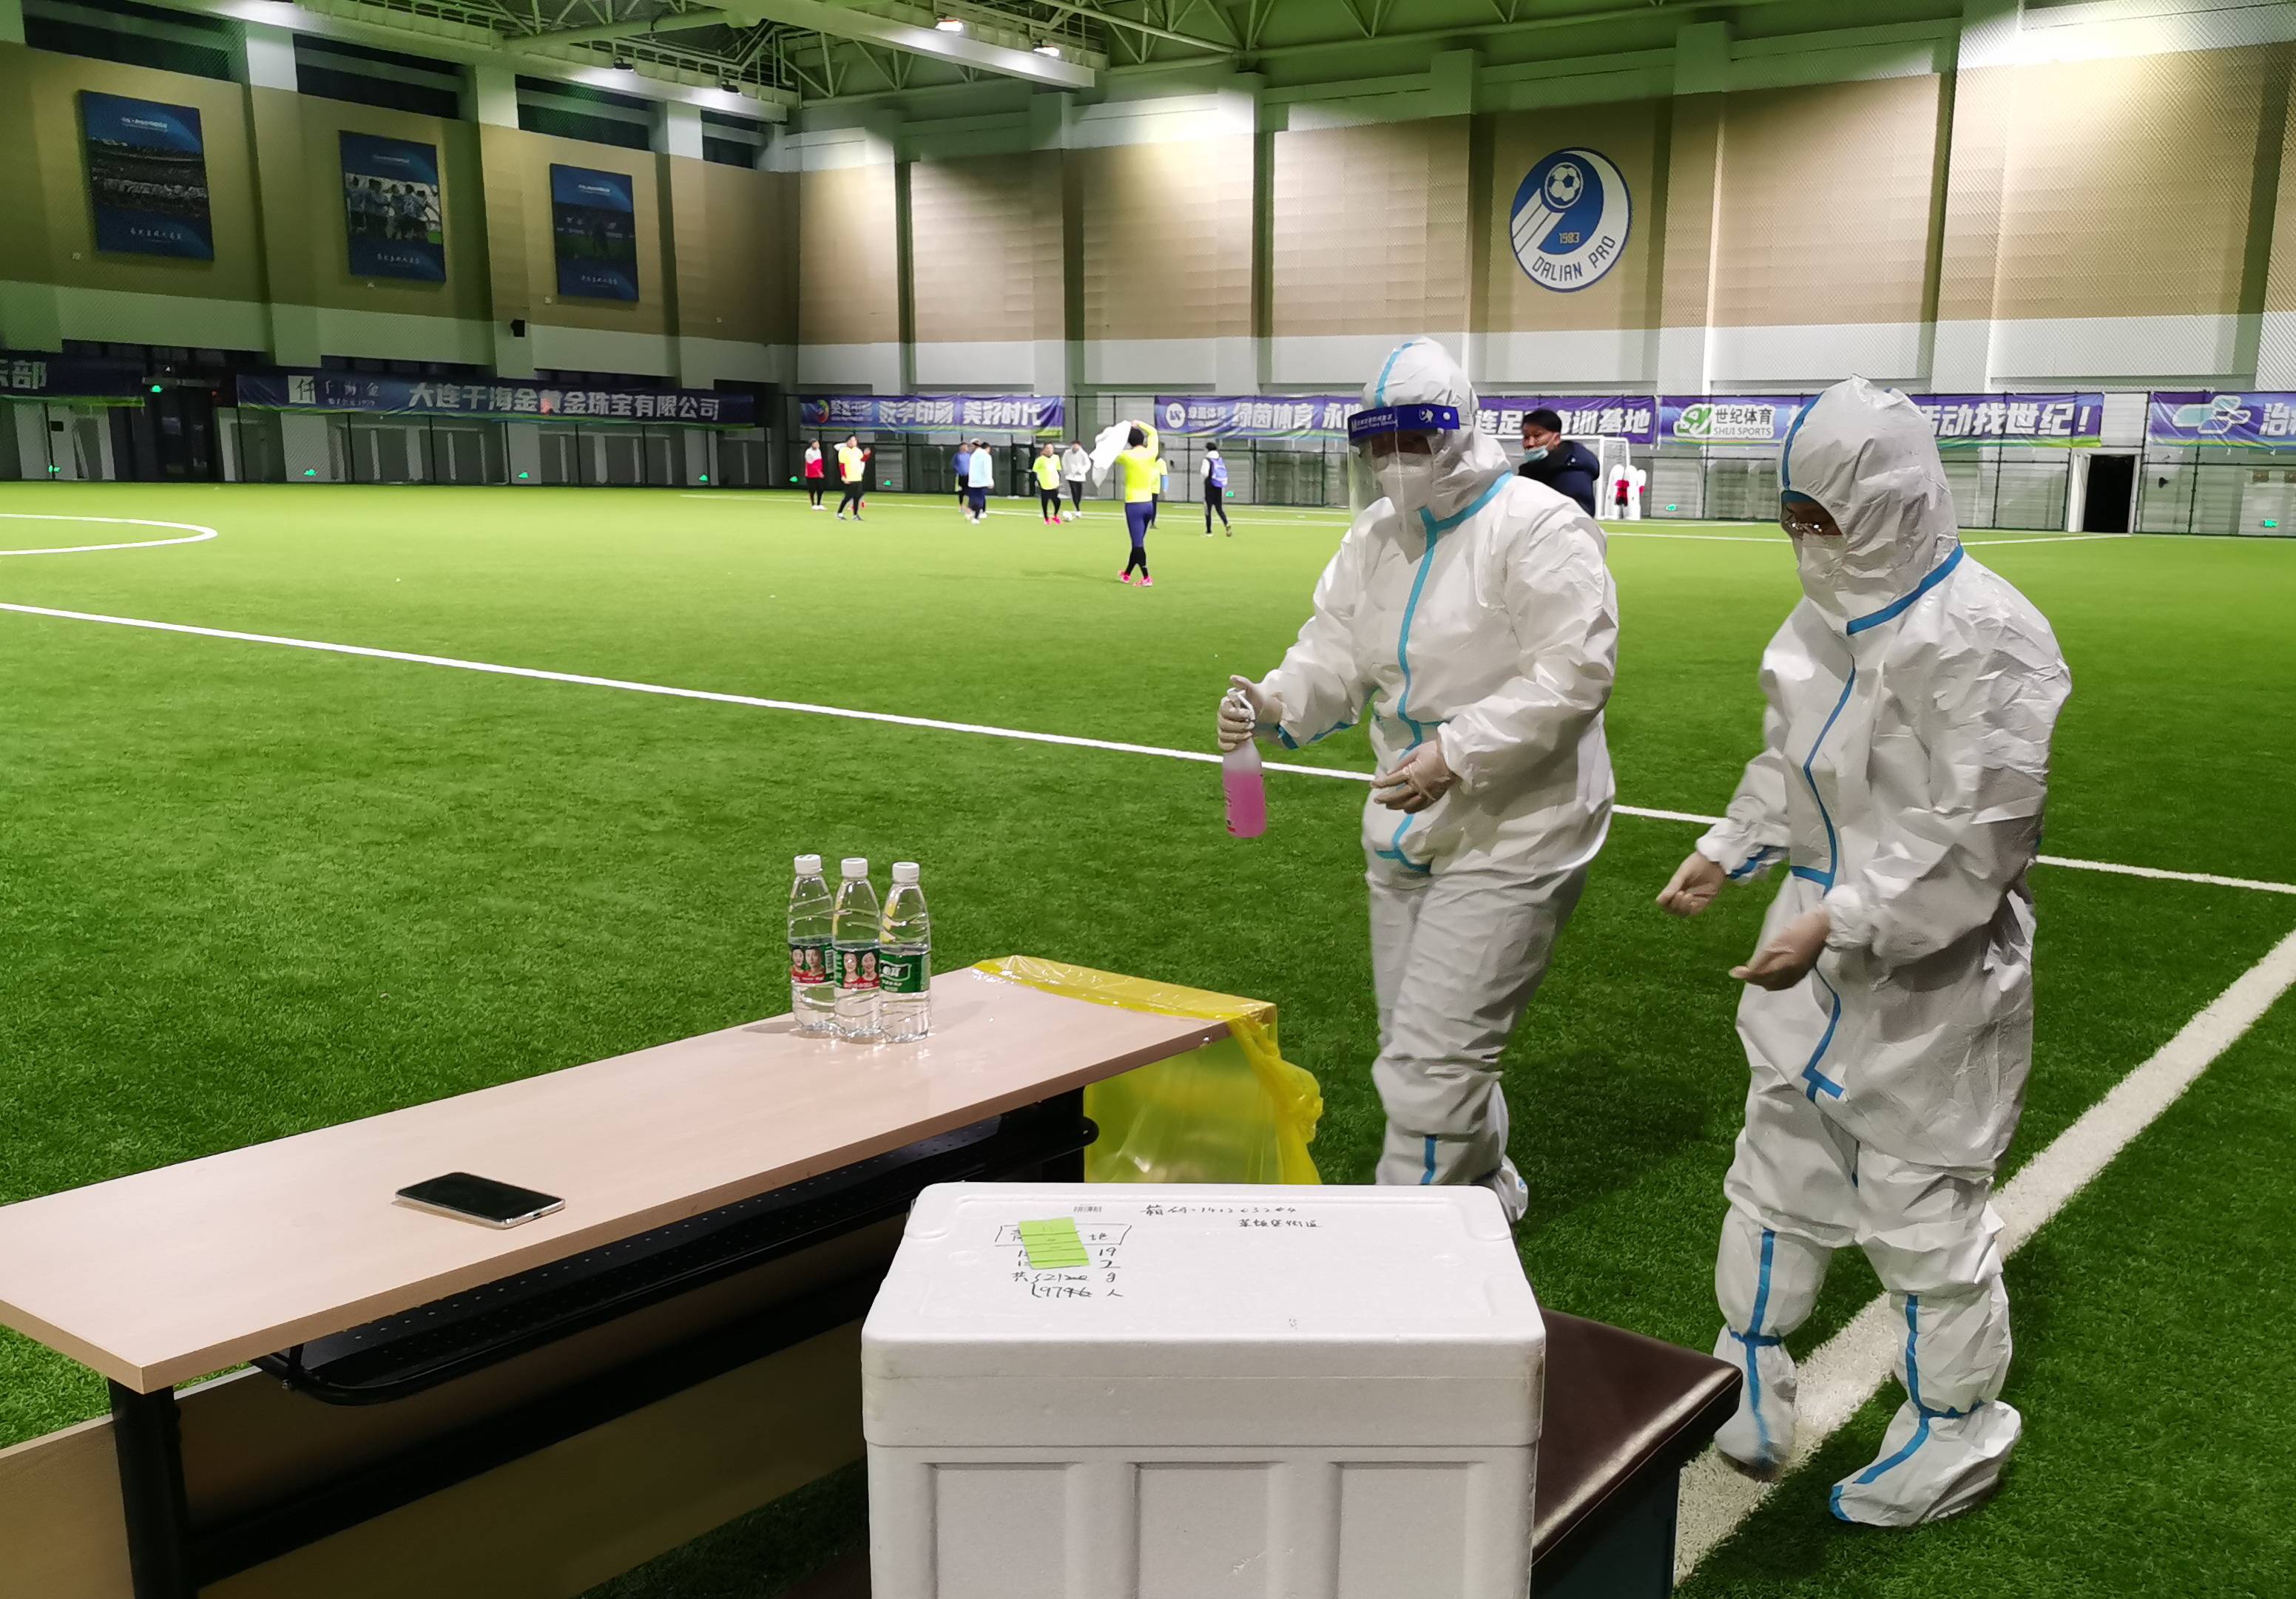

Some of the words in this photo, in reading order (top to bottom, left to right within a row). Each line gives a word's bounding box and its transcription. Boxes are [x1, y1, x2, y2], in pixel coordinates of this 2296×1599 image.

[1532, 256, 1583, 282] DALIAN
[1588, 235, 1616, 268] PRO
[1715, 408, 1773, 425] 世纪体育
[1738, 427, 1772, 436] SPORTS
